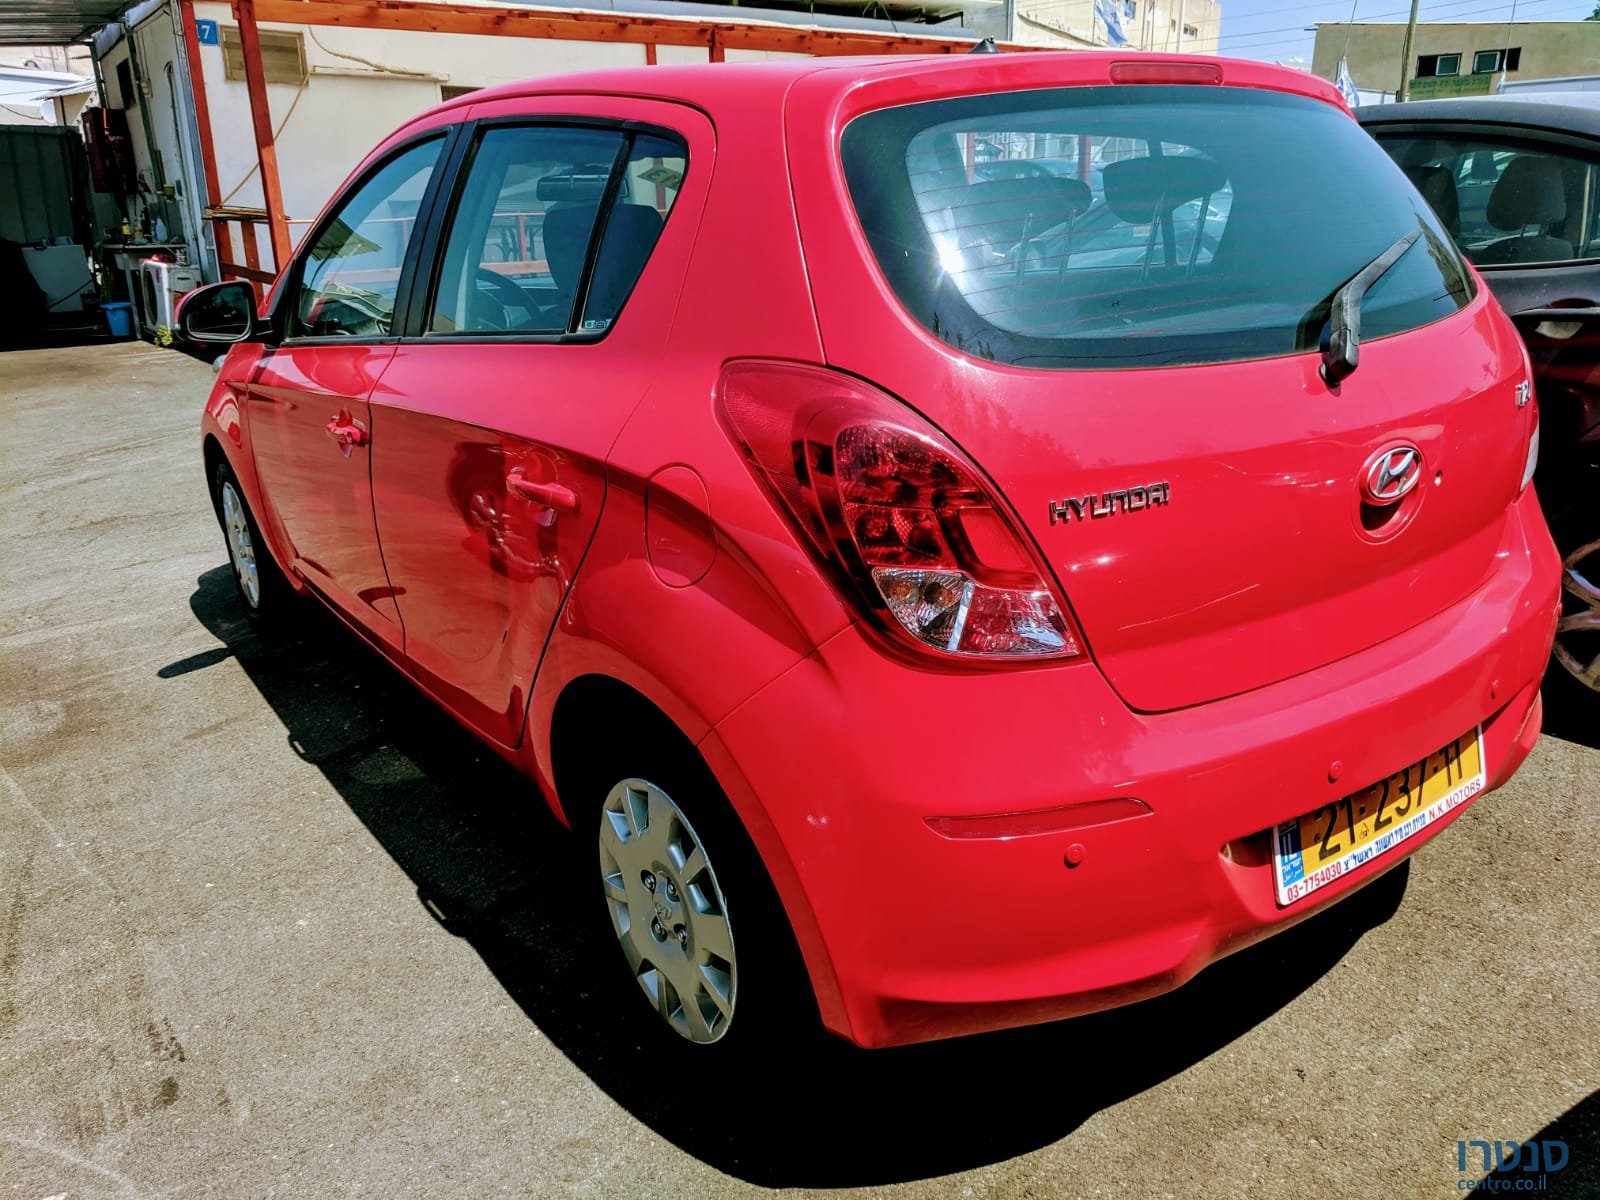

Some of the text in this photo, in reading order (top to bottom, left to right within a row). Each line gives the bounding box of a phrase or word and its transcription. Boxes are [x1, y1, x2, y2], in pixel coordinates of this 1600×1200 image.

[1049, 480, 1169, 525] HYUNDAI
[1428, 778, 1481, 821] N.K MOTORS
[1287, 862, 1342, 902] 03-7754030
